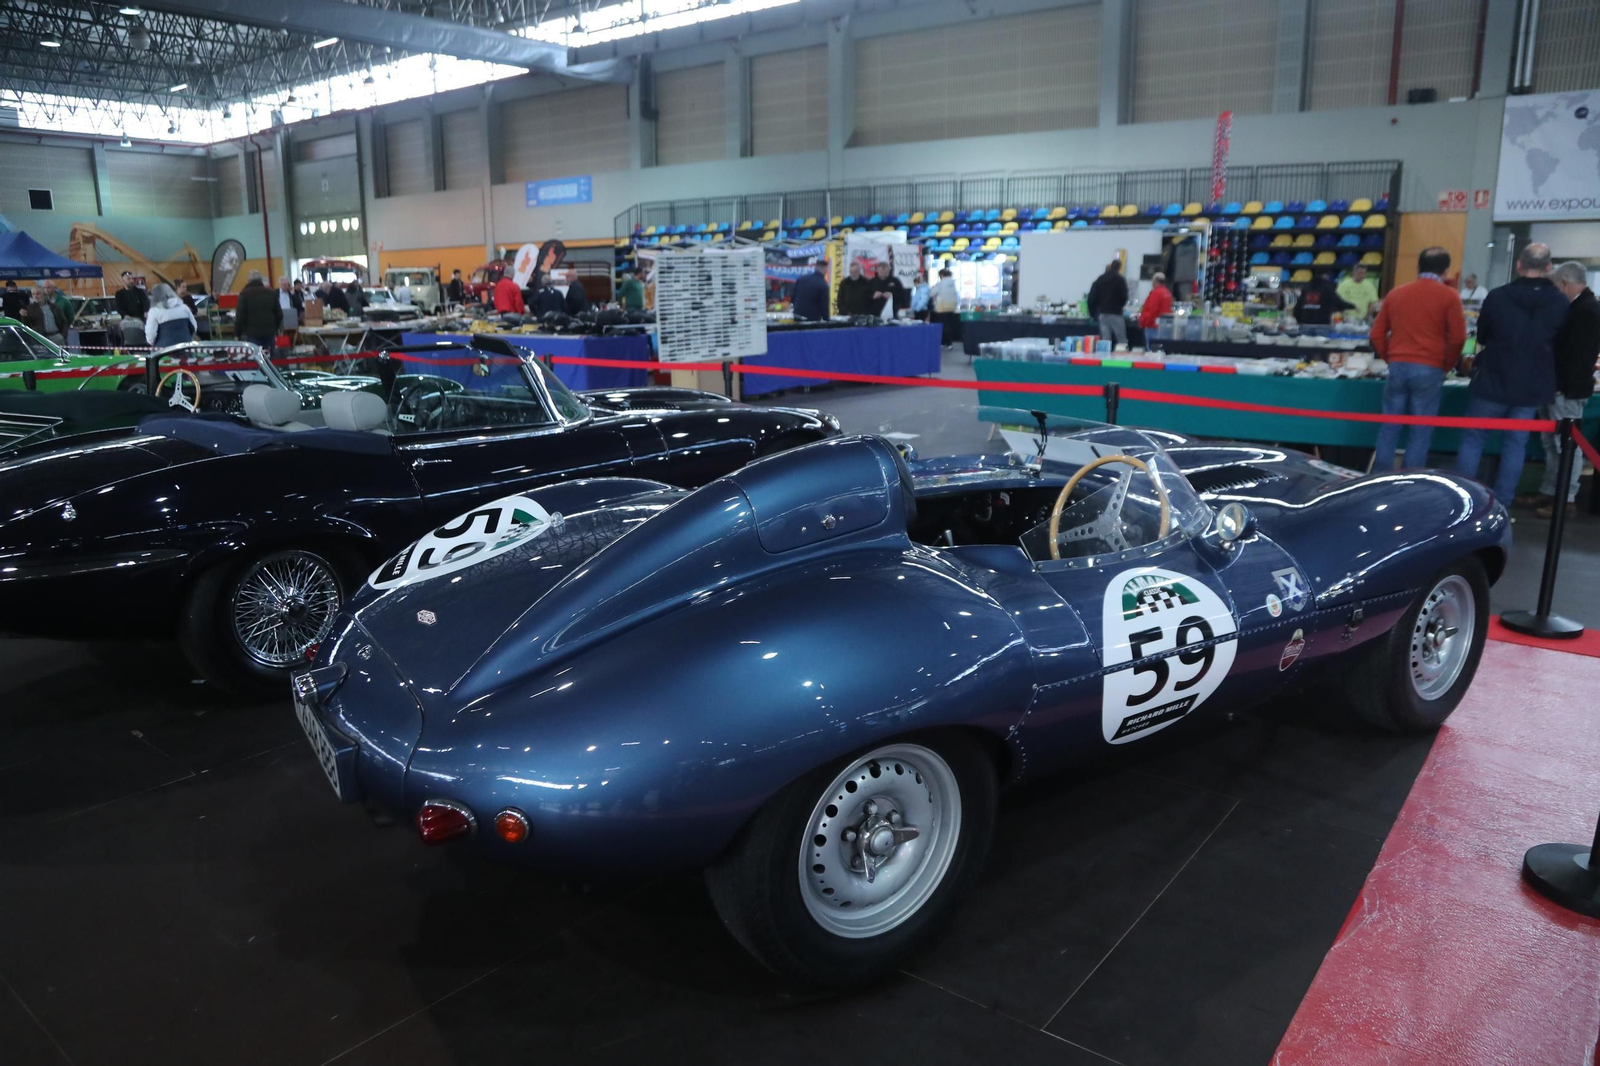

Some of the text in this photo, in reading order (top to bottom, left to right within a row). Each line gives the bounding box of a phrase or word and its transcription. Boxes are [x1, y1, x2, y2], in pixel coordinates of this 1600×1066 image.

[392, 554, 407, 576] MILLE
[1143, 587, 1163, 596] CLASSIC
[1126, 615, 1216, 707] 59
[1126, 700, 1191, 727] RICHARD MILLE
